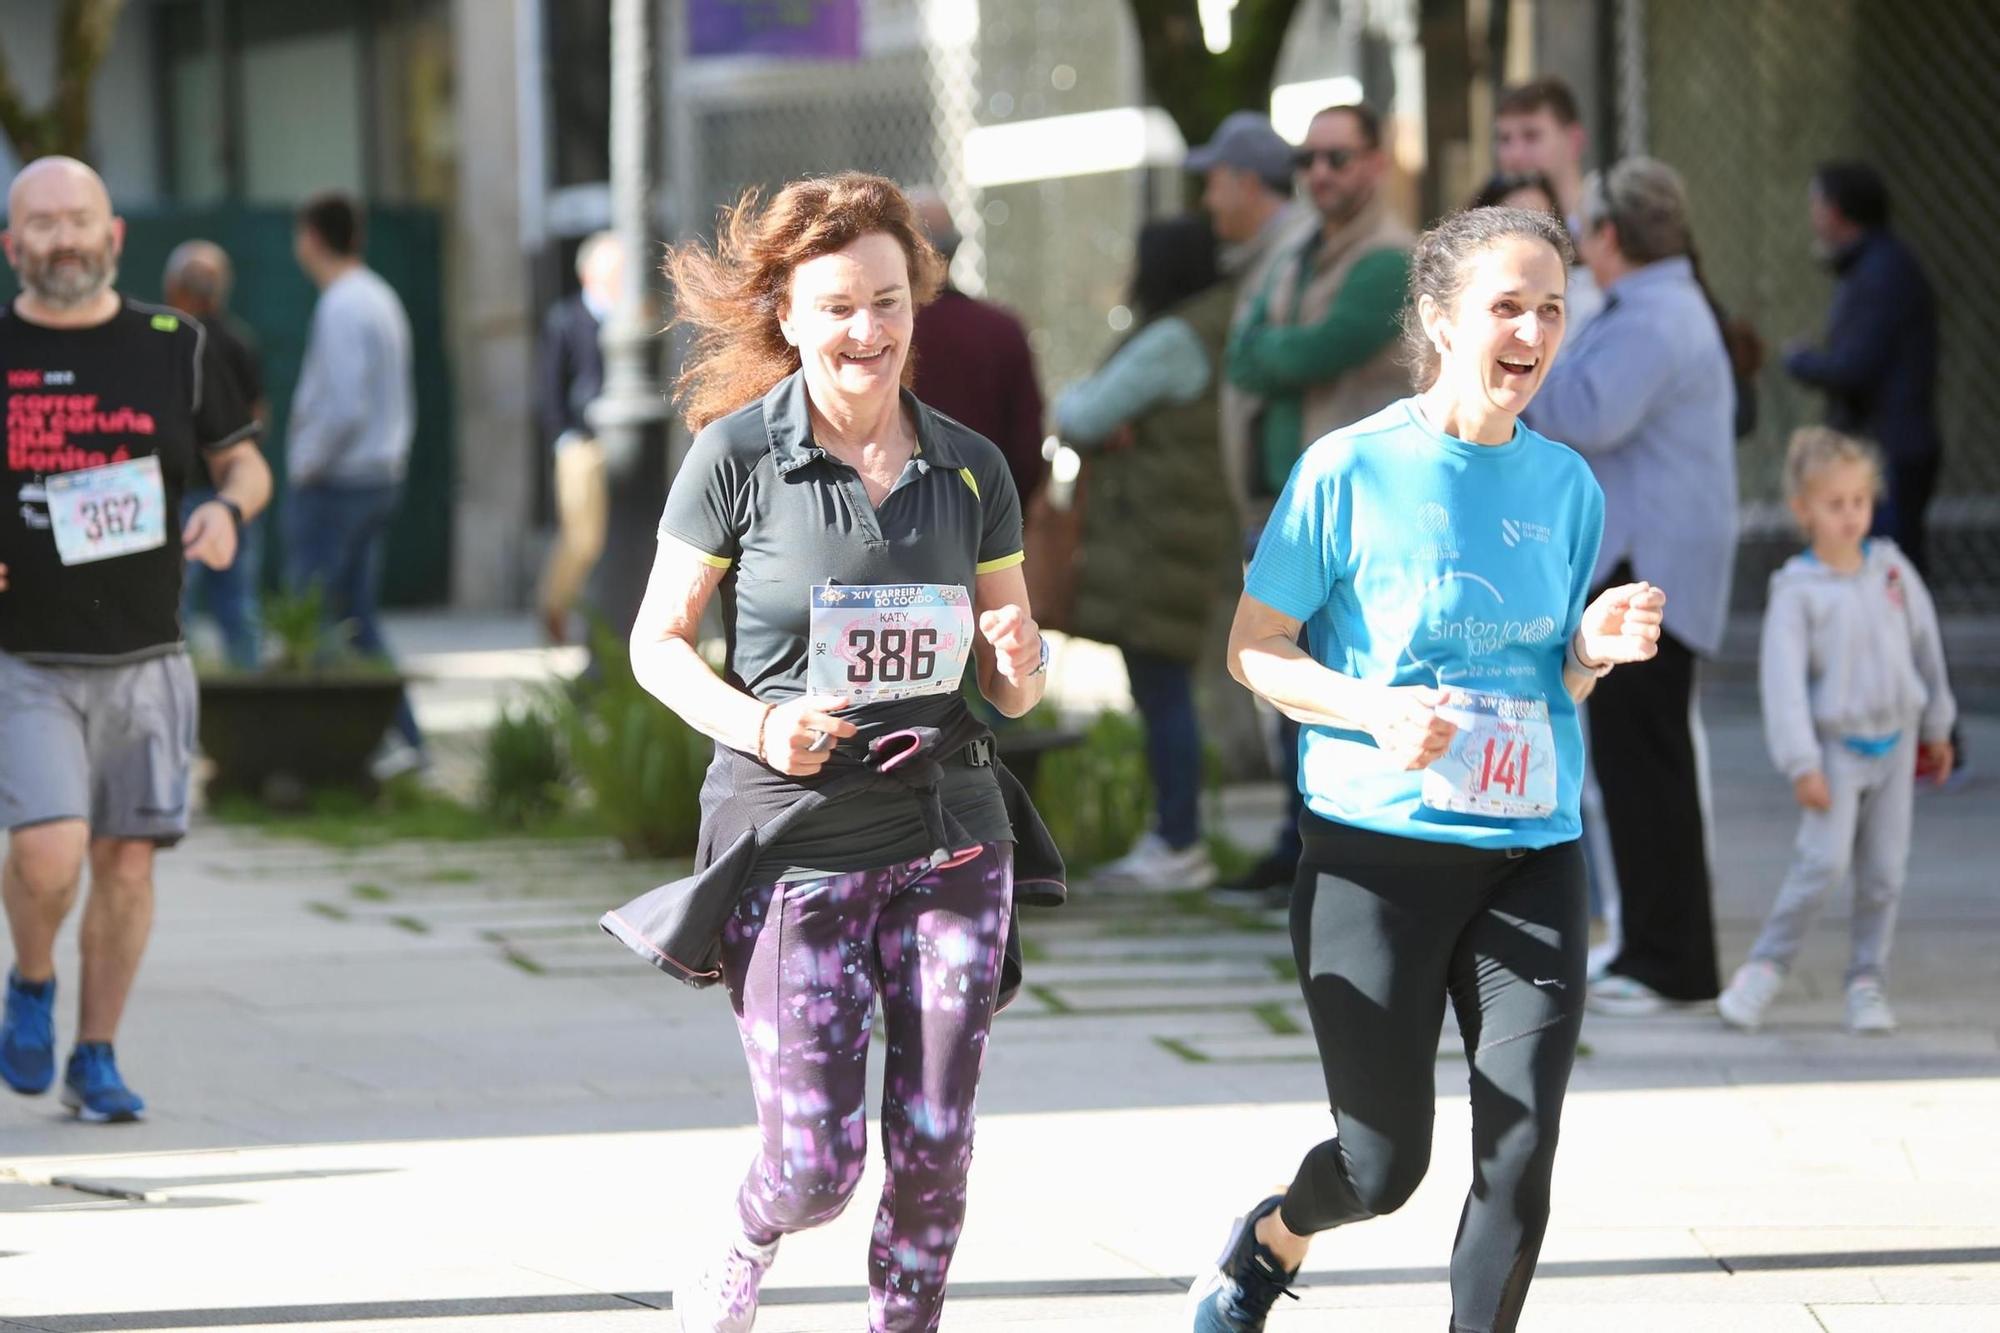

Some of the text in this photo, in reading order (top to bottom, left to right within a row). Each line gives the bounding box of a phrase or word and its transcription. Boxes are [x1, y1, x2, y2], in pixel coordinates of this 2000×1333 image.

[8, 394, 98, 413] correr
[7, 406, 155, 434] na coruña
[8, 446, 107, 470] bonito
[79, 493, 146, 542] 362
[852, 586, 923, 601] XIV CARREIRA
[874, 594, 934, 608] DO COCIDO
[879, 612, 910, 623] KATY
[815, 641, 827, 656] 5K
[846, 628, 938, 683] 386
[1480, 736, 1530, 797] 141
